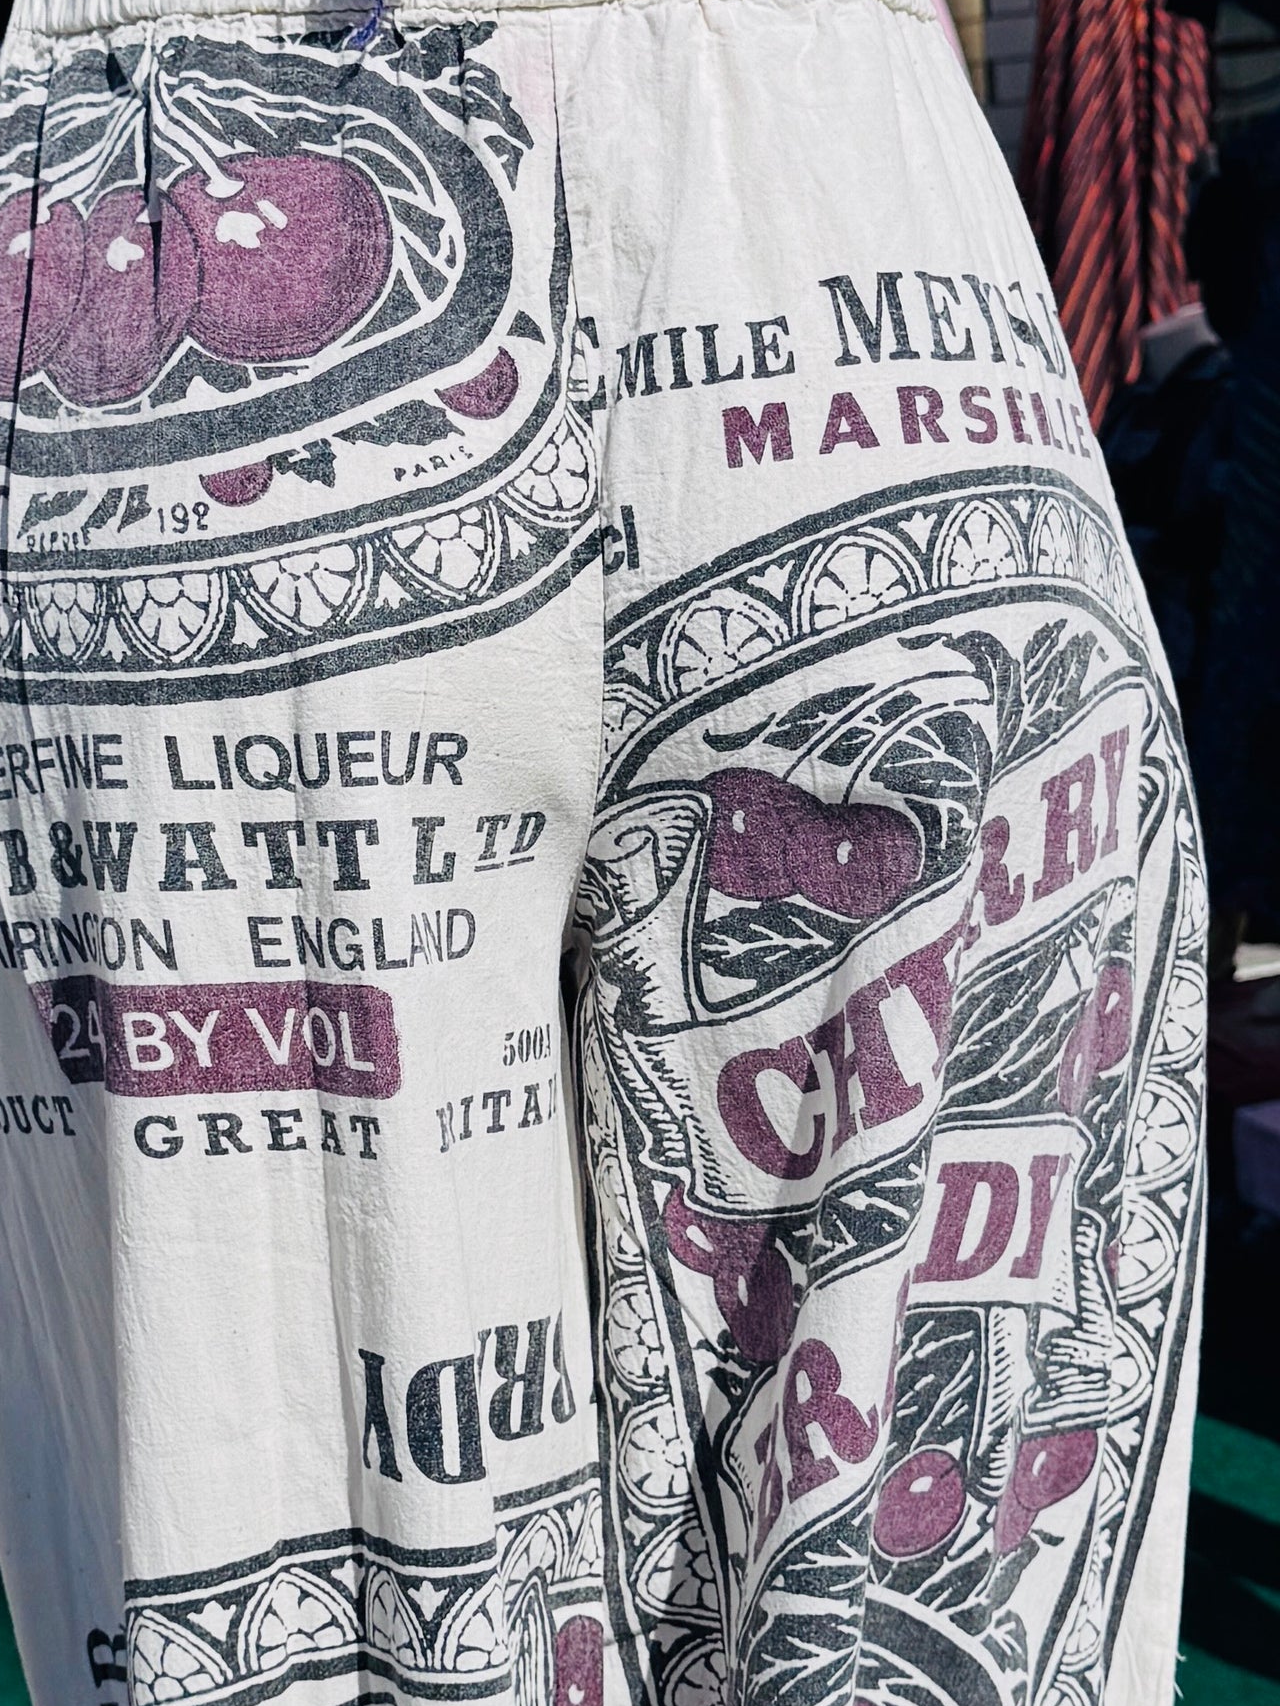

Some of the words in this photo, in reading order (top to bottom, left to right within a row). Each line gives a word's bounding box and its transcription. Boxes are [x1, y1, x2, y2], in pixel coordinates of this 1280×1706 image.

[165, 731, 468, 790] LIQUEUR
[250, 907, 476, 972] ENGLAND
[122, 1006, 222, 1073] BY
[245, 1005, 376, 1073] VOL
[134, 1109, 381, 1162] GREAT
